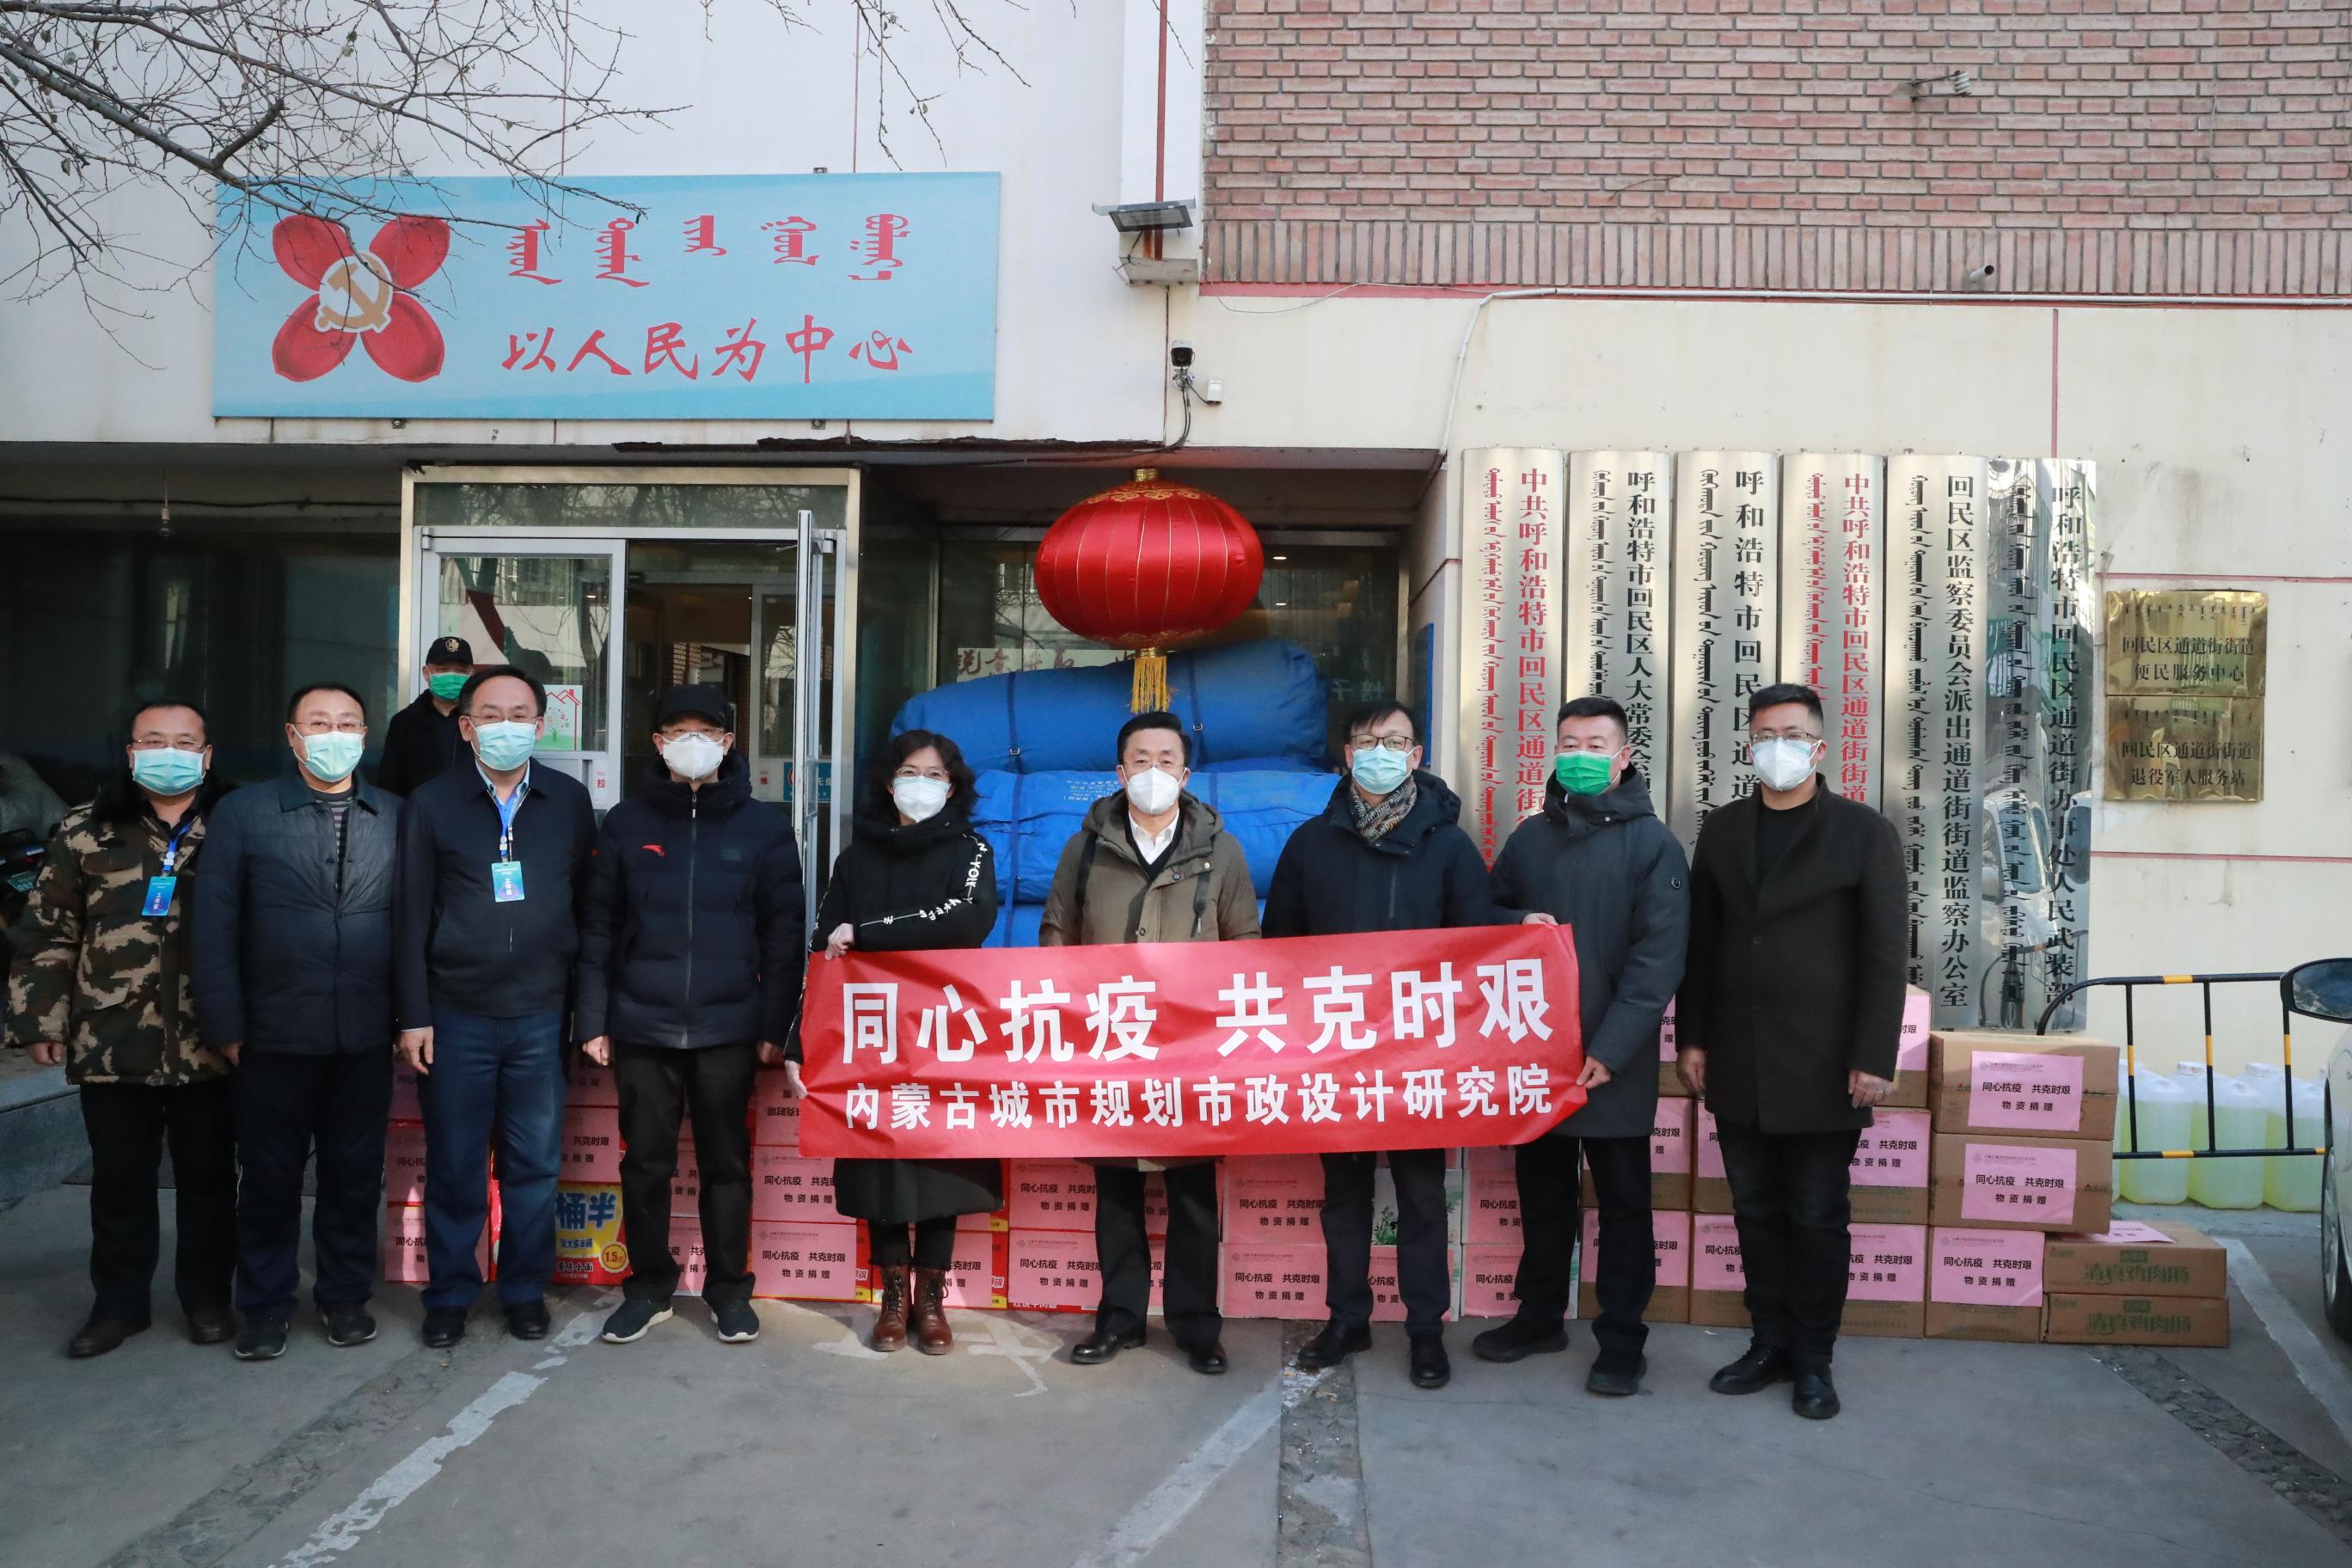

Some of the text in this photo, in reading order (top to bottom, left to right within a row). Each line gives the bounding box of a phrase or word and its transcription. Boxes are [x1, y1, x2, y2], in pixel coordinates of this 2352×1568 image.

[501, 315, 913, 384] 以人民为中心
[1515, 468, 1548, 823] 中共呼和浩特市回民区通道街
[2122, 636, 2255, 656] 回民区通道街街道
[2135, 663, 2245, 682] 便民服务中心
[1940, 475, 1975, 1008] 回民区监察委员会派出通道街街道监察办公室
[2121, 741, 2252, 760] 回民区通道街街道
[597, 778, 606, 788] 拉
[2131, 768, 2245, 787] 退役军人服务站
[842, 959, 1554, 1065] 同心抗疫 共克时艰
[1982, 1081, 2071, 1094] 同心抗疫 共克时艰
[844, 1061, 1553, 1131] 内蒙古城市规划市政设计研究院
[2001, 1100, 2053, 1112] 物资捐赠
[573, 1136, 609, 1146] 共克时艰
[1857, 1139, 1917, 1150] 疫 共克时艰
[764, 1175, 801, 1185] 同心抗疫
[1975, 1174, 2064, 1188] 同心抗疫 共克时艰
[1020, 1183, 1058, 1193] 同心抗疫
[784, 1194, 833, 1204] 物资捐赠
[1240, 1199, 1277, 1209] 同心抗疫
[1995, 1193, 2046, 1204] 物资捐赠
[1040, 1201, 1090, 1211] 物资捐赠
[1479, 1199, 1517, 1210] 同心抗疫
[1260, 1217, 1309, 1226] 物资捐赠
[395, 1237, 426, 1246] 同心抗
[763, 1251, 846, 1262] 同心抗疫 共克时艰
[1874, 1255, 1913, 1265] 共克时艰
[950, 1260, 982, 1271] 克时艰
[1020, 1259, 1057, 1269] 同心抗疫
[1944, 1256, 2032, 1270] 同心抗疫 共克时艰
[782, 1269, 830, 1279] 物资捐赠
[1235, 1272, 1320, 1283] 同心抗疫 共克时艰
[1476, 1274, 1513, 1284] 同心抗疫
[1039, 1277, 1088, 1288] 物资捐赠
[1964, 1276, 2016, 1287] 物资捐赠
[1255, 1290, 1304, 1301] 物资捐赠
